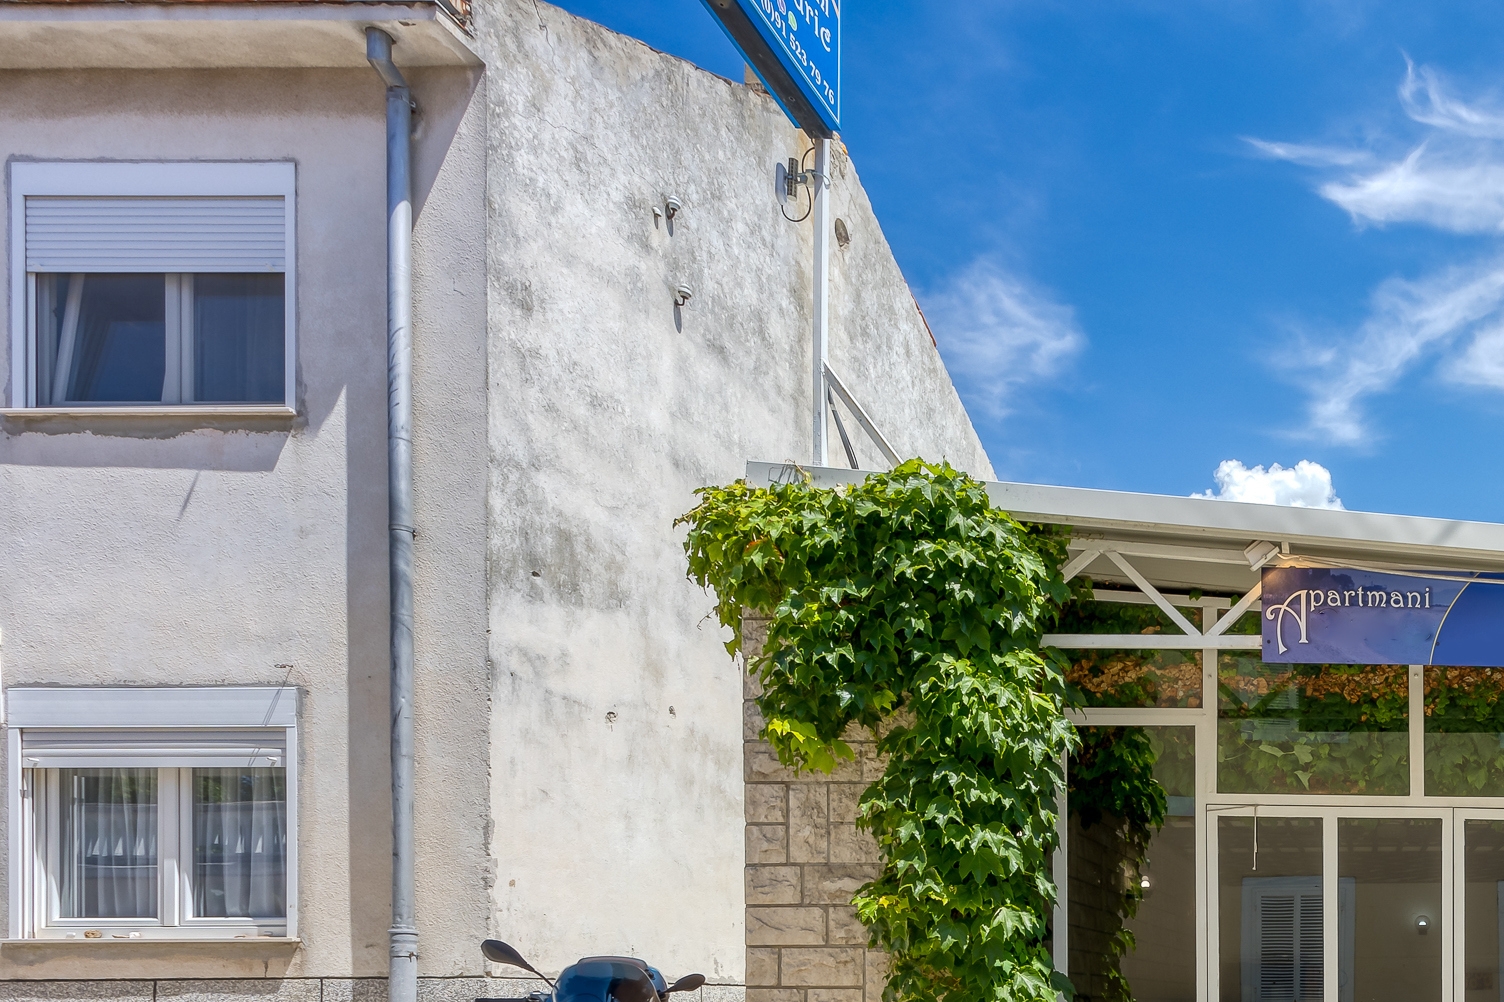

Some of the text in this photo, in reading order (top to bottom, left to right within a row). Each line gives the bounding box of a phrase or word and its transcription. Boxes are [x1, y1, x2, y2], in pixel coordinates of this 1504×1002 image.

[790, 32, 807, 66] 523
[809, 60, 821, 85] 79
[823, 80, 835, 105] 76
[1266, 587, 1432, 655] Apartmani
